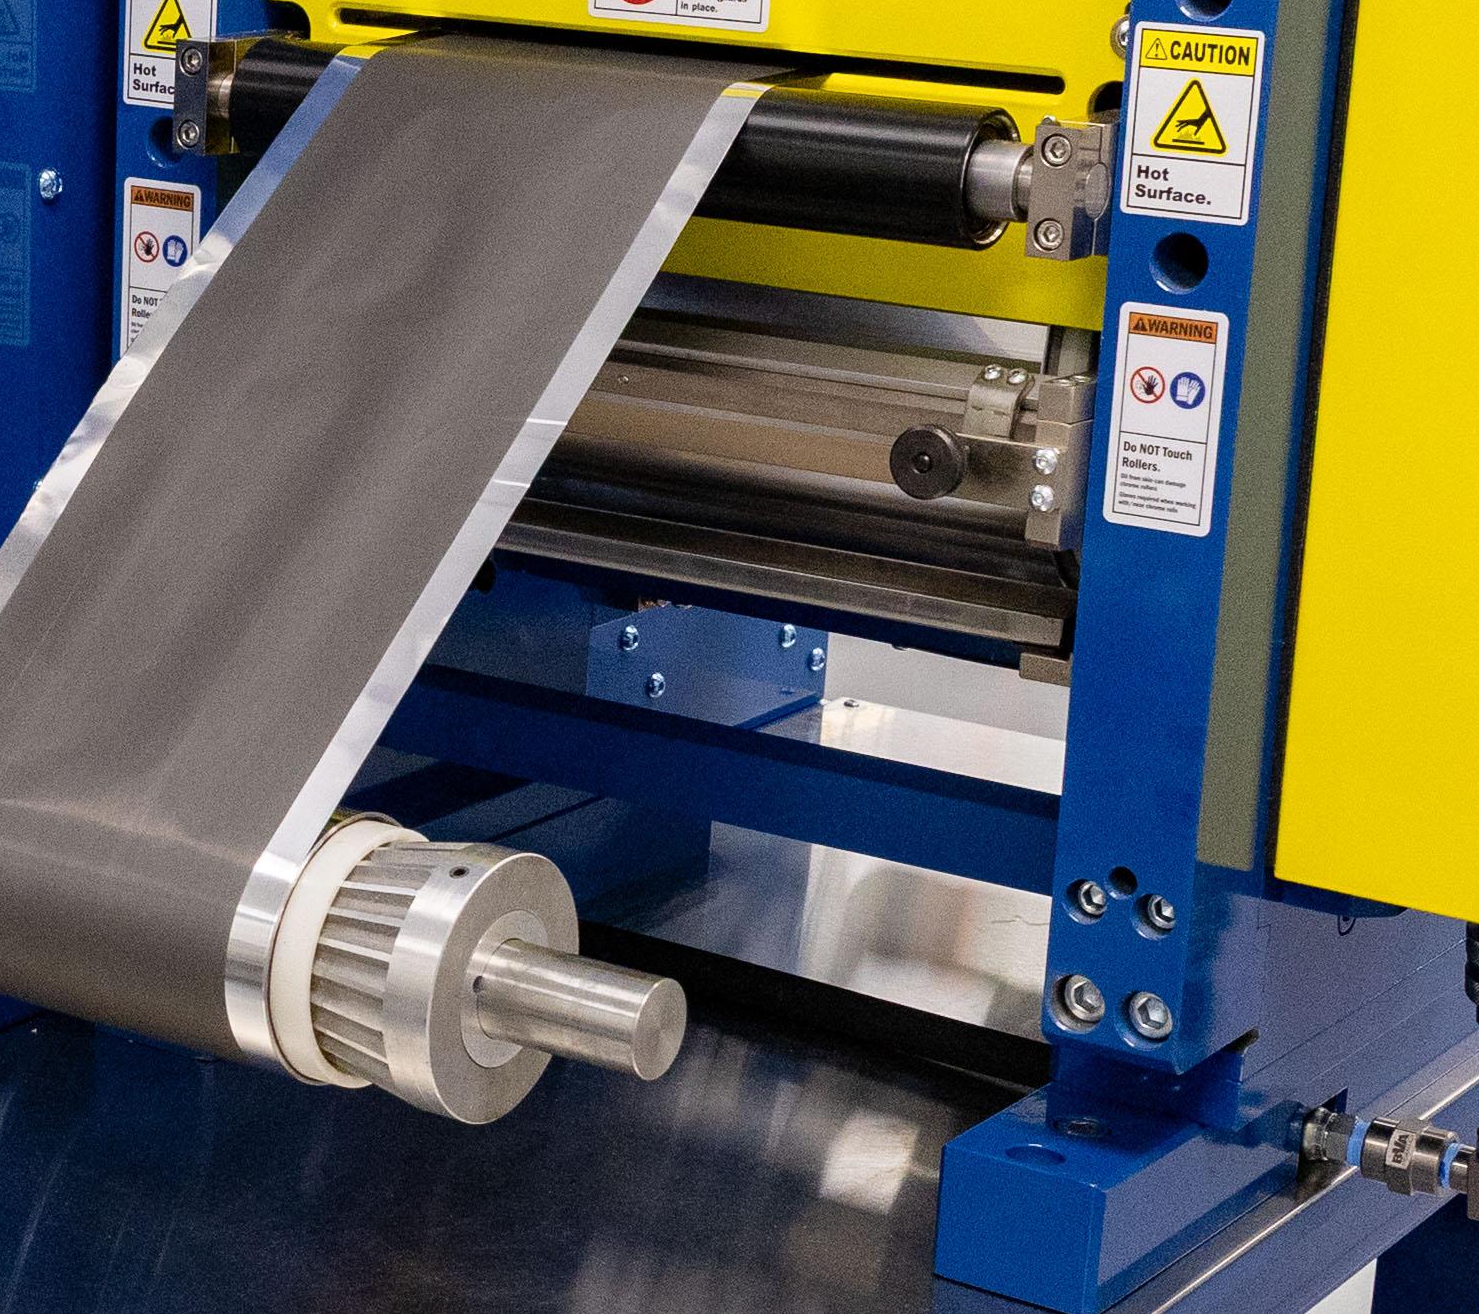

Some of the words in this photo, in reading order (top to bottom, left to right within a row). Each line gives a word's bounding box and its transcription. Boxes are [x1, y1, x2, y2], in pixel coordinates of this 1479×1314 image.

[681, 1, 689, 10] in
[691, 2, 719, 13] place.
[1170, 40, 1250, 66] CAUTION
[133, 62, 157, 77] Hot
[132, 78, 175, 94] Surfac
[1137, 164, 1169, 182] Hot
[145, 192, 191, 212] WARNING
[1135, 184, 1212, 205] Surface.
[132, 295, 142, 304] Do
[143, 296, 159, 307] NOT
[132, 308, 151, 319] Rolle
[1148, 318, 1212, 339] WARNING
[1123, 440, 1136, 453] Do
[1139, 443, 1160, 456] NOT
[1162, 445, 1192, 461] Touch
[1122, 457, 1161, 473] Rollers.
